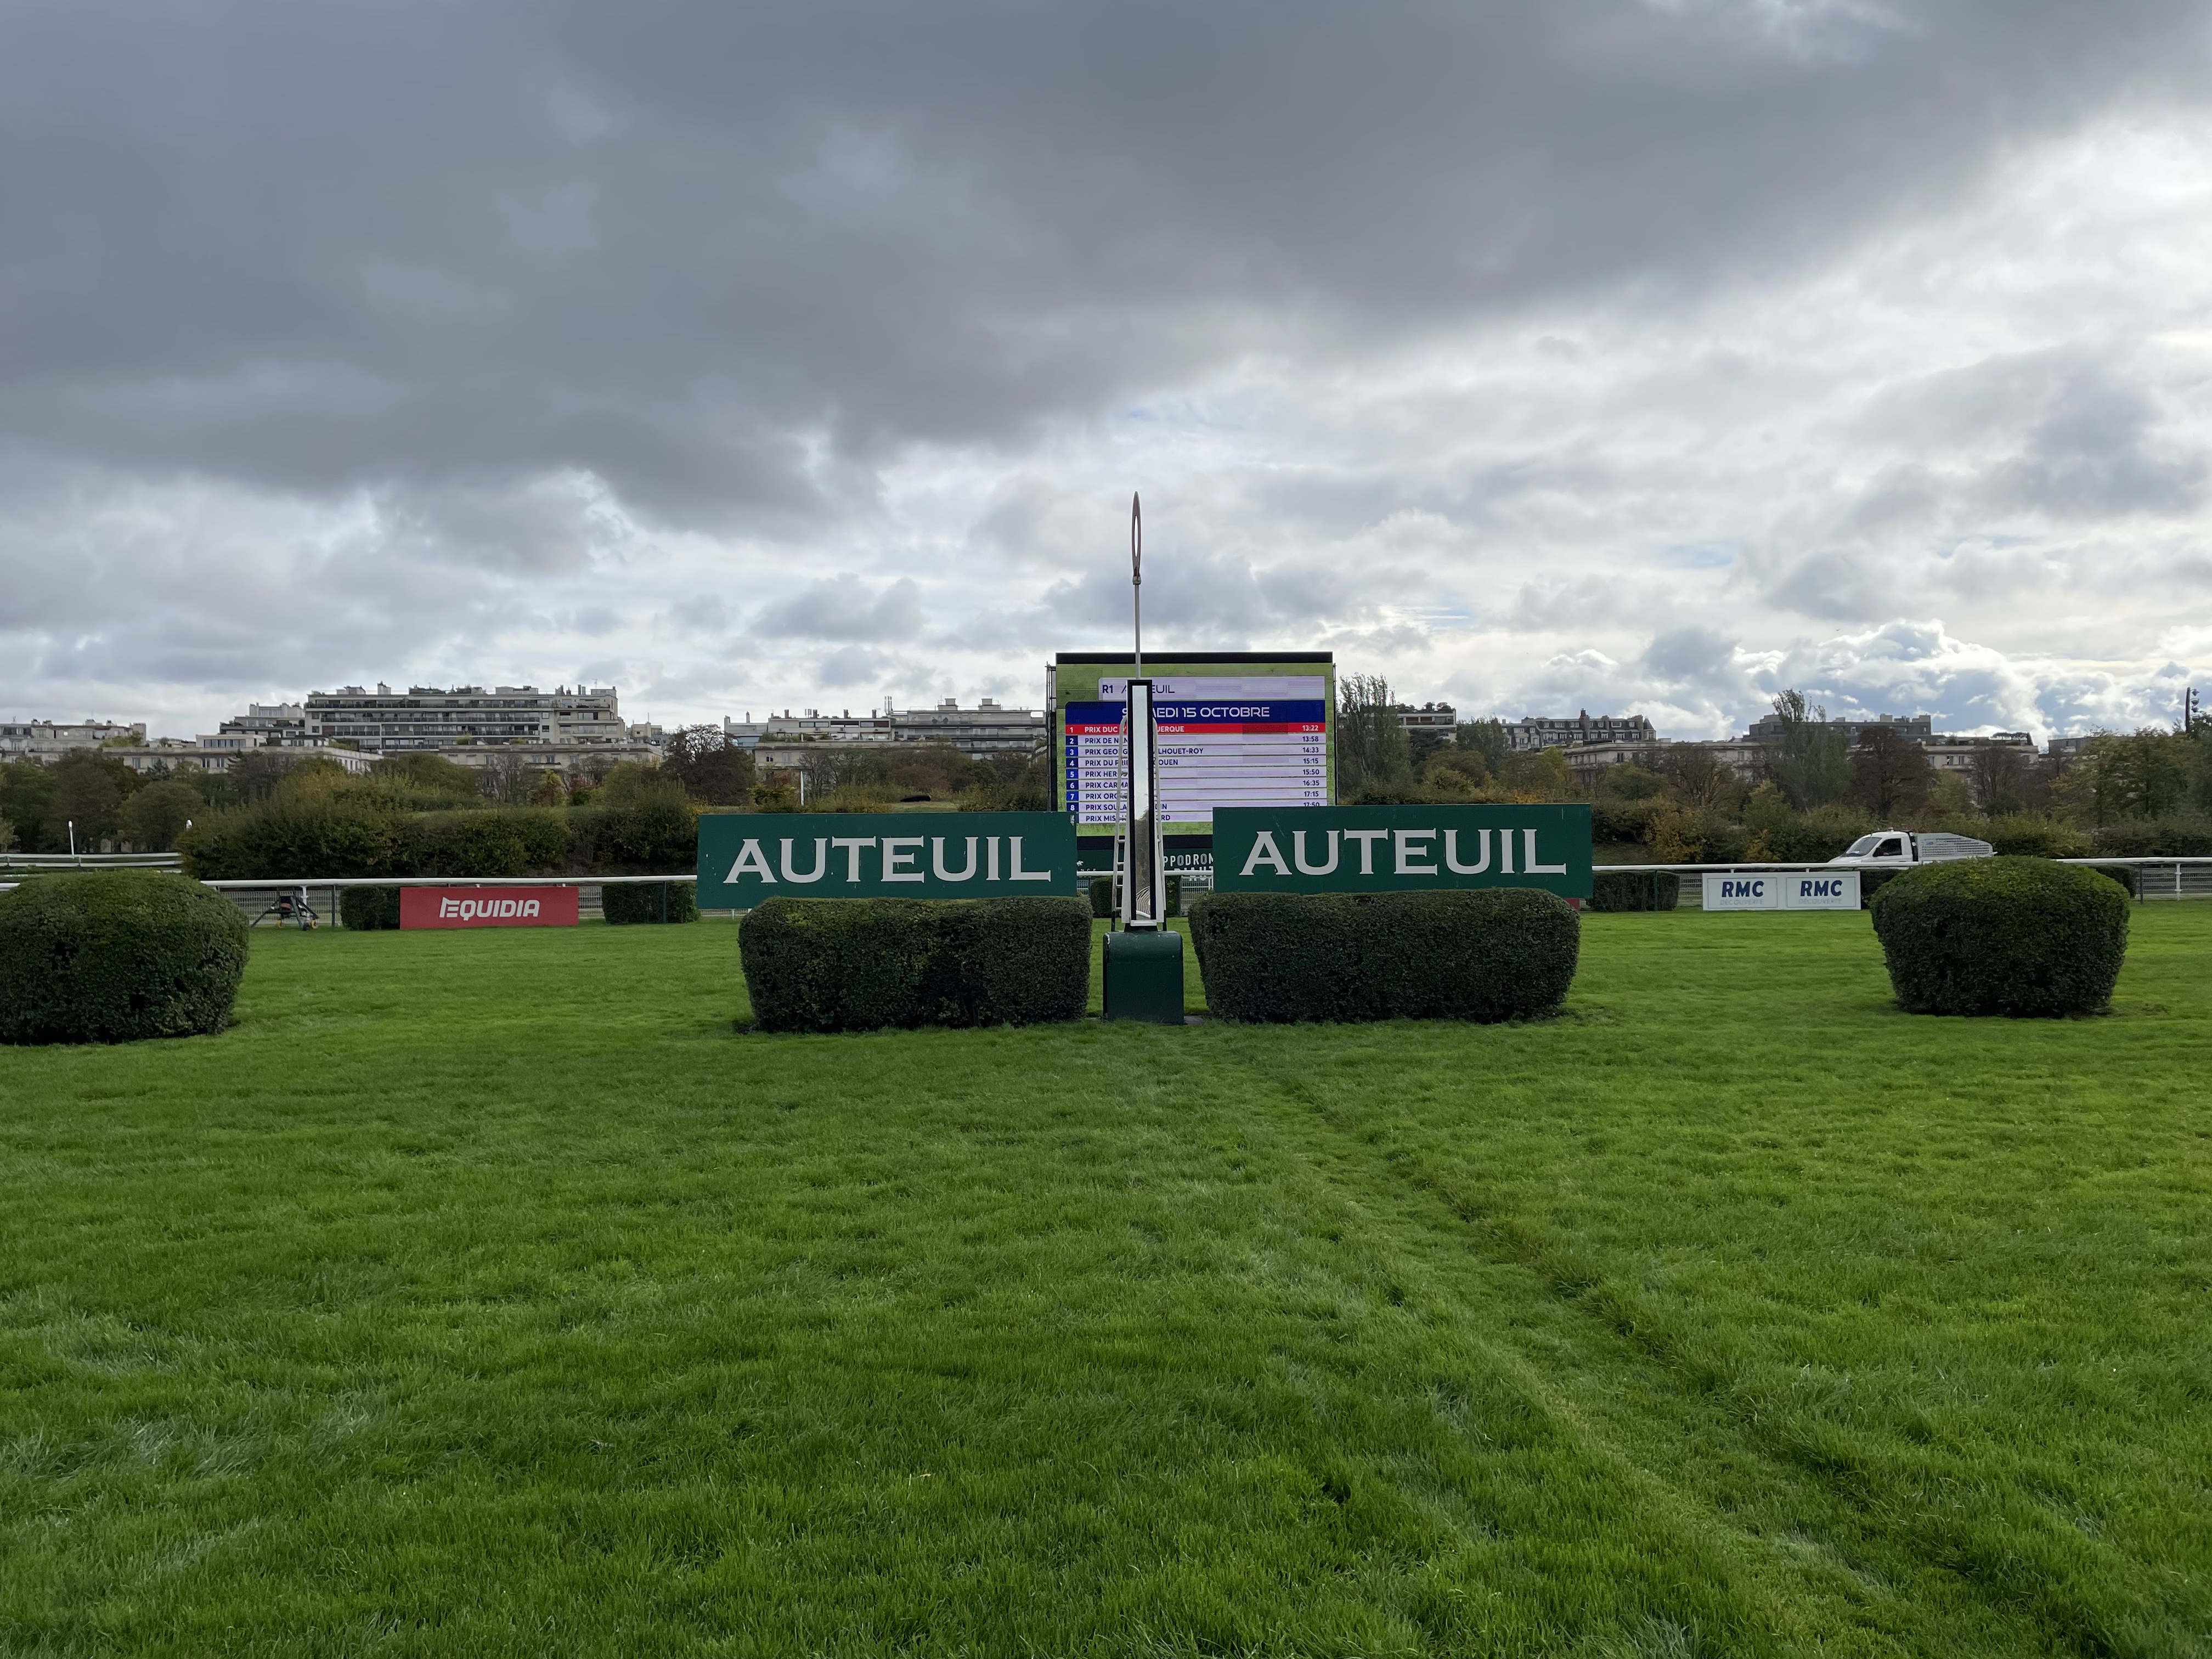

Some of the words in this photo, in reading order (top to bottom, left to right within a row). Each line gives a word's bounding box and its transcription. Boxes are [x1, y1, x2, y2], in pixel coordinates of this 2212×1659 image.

[1102, 685, 1113, 694] R1
[1182, 707, 1196, 718] 15
[1200, 707, 1271, 718] OCTOBRE
[723, 835, 1052, 884] AUTEUIL
[1239, 827, 1567, 876] AUTEUIL
[1722, 881, 1764, 898] RMC
[1800, 880, 1843, 897] RMC
[439, 896, 540, 922] EQUIDIA
